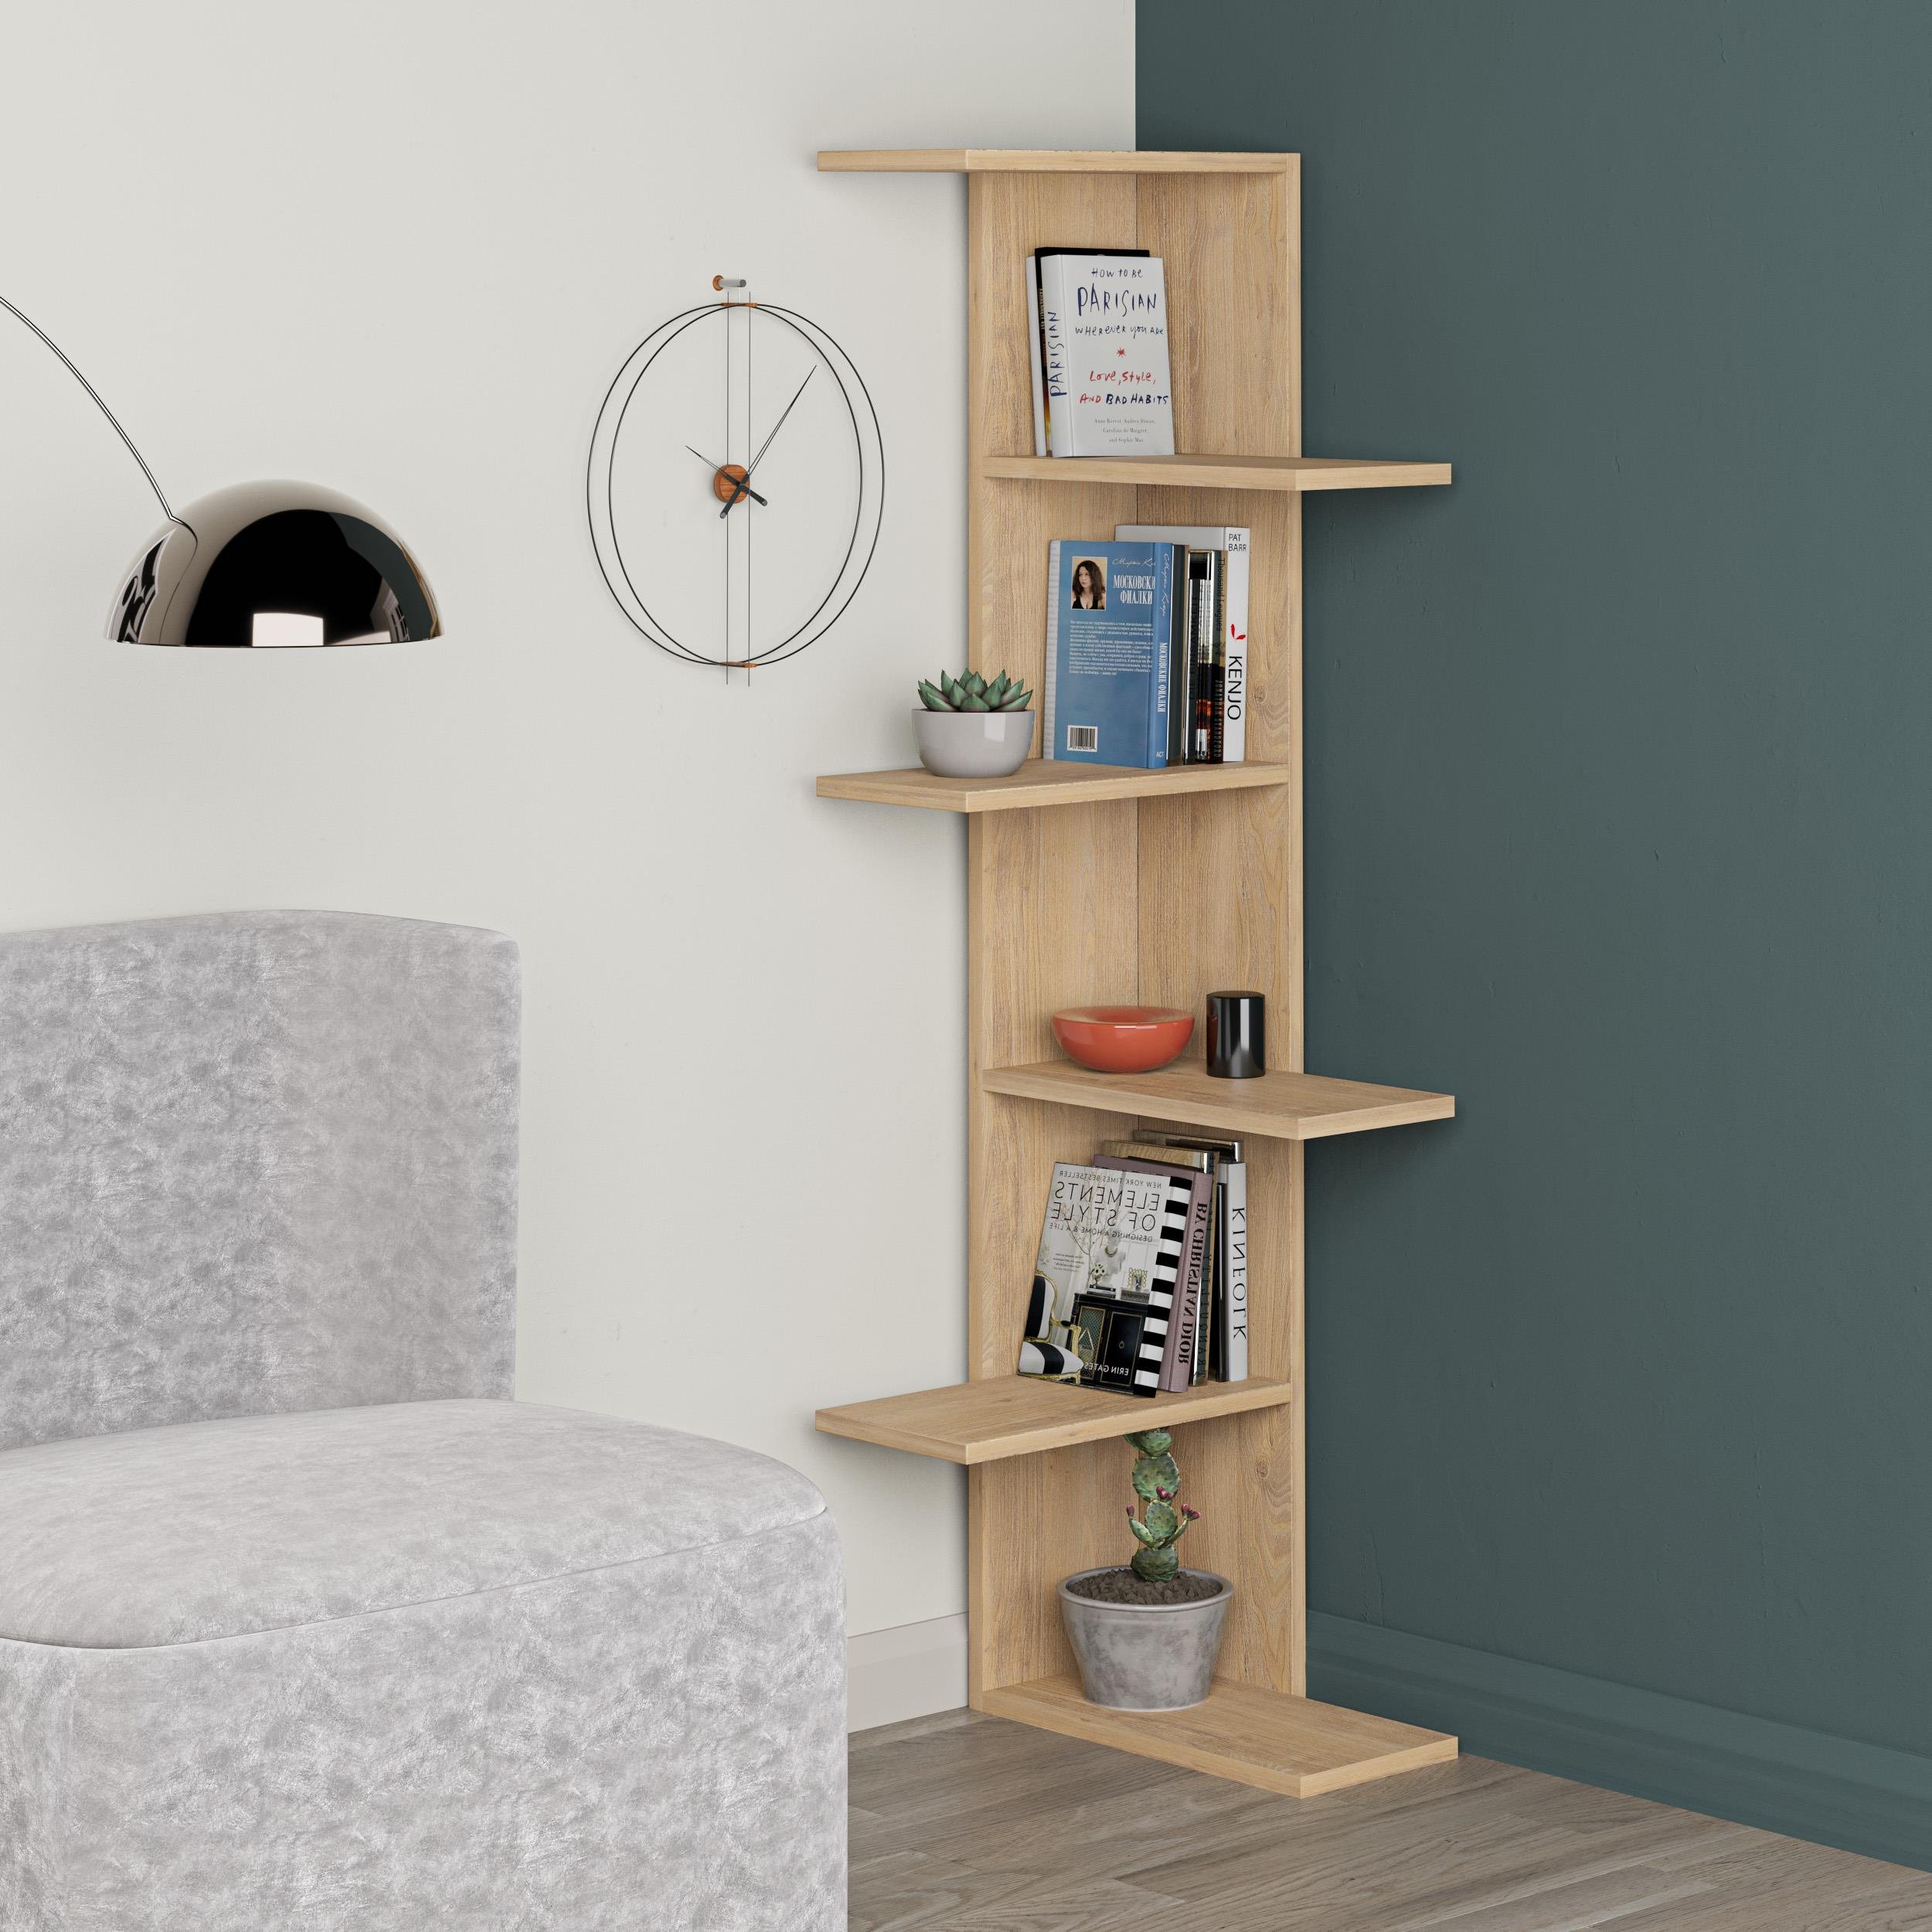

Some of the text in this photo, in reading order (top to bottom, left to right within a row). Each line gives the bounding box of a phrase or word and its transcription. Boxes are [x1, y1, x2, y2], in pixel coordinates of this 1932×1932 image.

[1077, 283, 1157, 317] PARISIAN
[1047, 311, 1067, 396] PARISIAN
[1106, 393, 1128, 405] BAD
[1228, 543, 1247, 552] BARR
[1229, 533, 1242, 542] PAT
[1120, 590, 1153, 604] ФИАЛКИ
[1215, 557, 1226, 631] Thousand Leagues
[1158, 642, 1168, 713] МОСКОВСКИЕ ФИАЛКИ
[1227, 656, 1243, 720] KENJO
